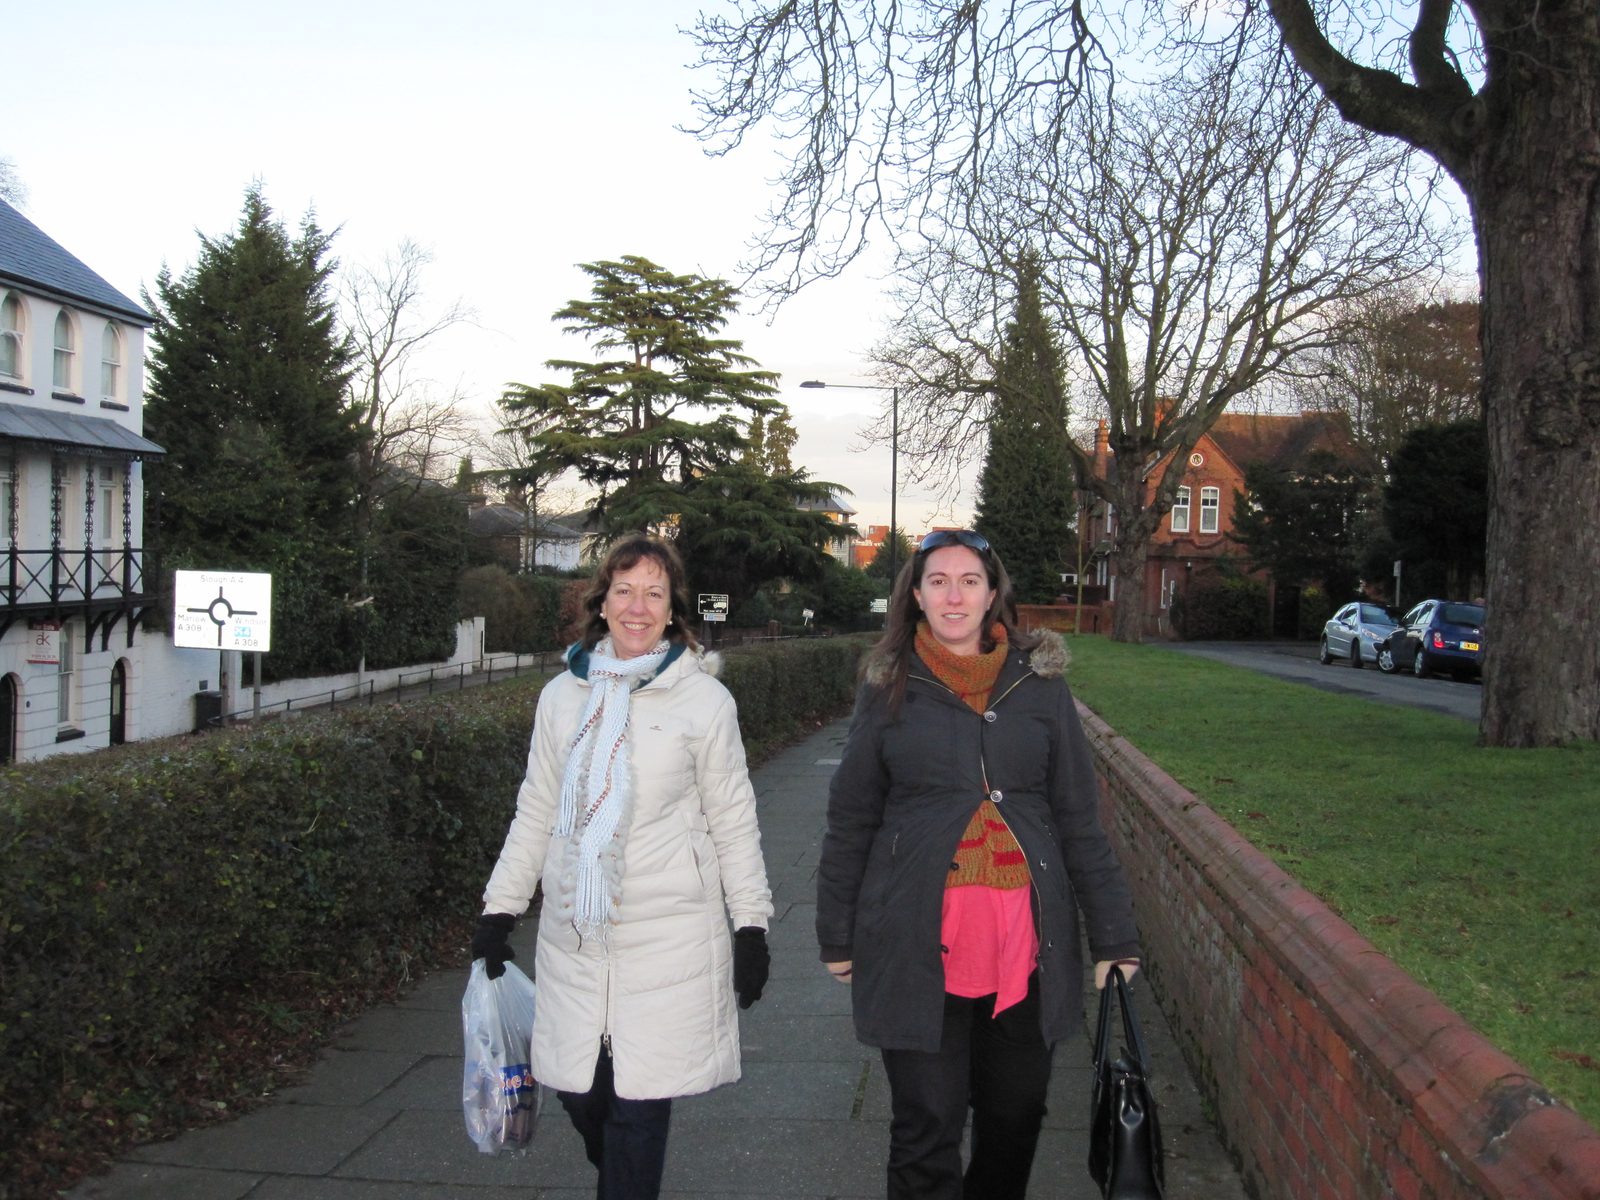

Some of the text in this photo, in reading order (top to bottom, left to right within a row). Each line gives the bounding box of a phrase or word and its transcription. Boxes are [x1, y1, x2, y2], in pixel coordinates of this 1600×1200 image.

[200, 574, 228, 583] Slough
[178, 614, 206, 623] Marlow
[234, 617, 267, 625] Wndsor
